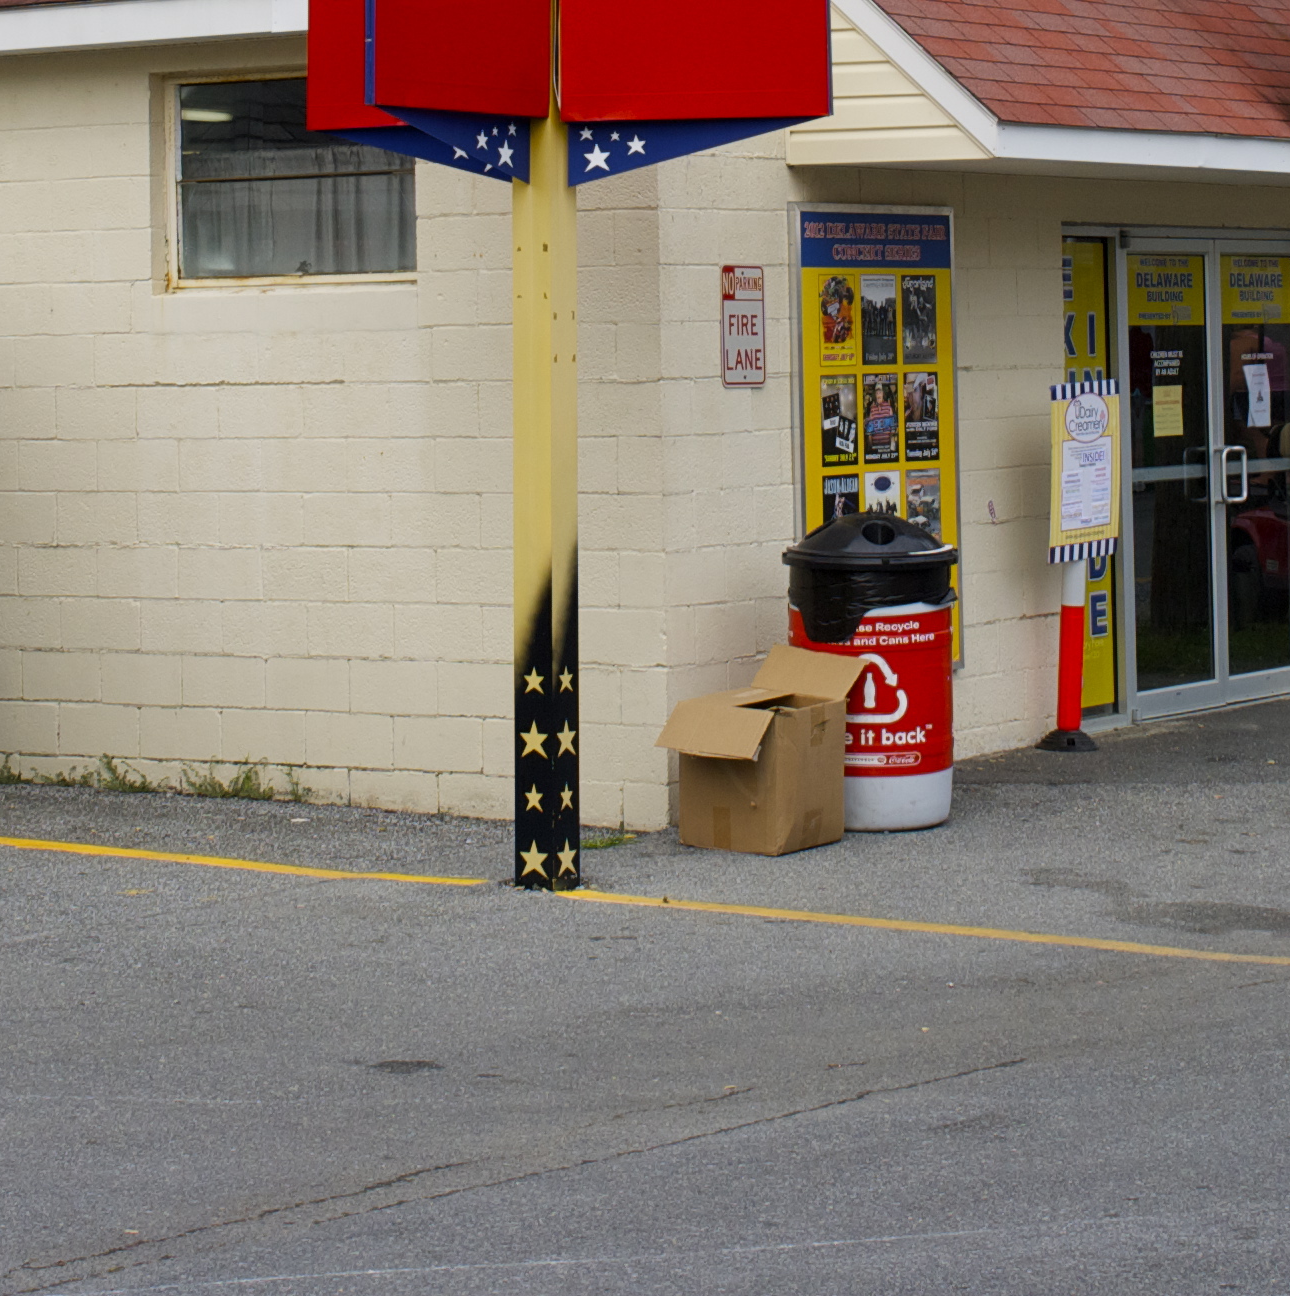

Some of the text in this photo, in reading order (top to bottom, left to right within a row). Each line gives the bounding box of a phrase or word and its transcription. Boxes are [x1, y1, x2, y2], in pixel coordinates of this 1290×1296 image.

[826, 222, 886, 240] DELAWARE
[888, 223, 920, 240] STATE
[922, 224, 946, 241] FAIR
[832, 244, 883, 261] CONCERT
[722, 272, 762, 295] NO PARKING
[1136, 272, 1193, 288] DELAWARE
[1229, 272, 1283, 288] DELAWARE
[1147, 290, 1183, 302] BUILDING
[1240, 290, 1274, 302] BUILDING
[729, 314, 758, 336] FIRE
[726, 349, 762, 371] LANE
[1069, 418, 1105, 434] Creamery
[876, 621, 920, 633] Recycle
[853, 636, 876, 646] and
[879, 635, 909, 645] Cans
[911, 632, 935, 643] Here
[861, 728, 875, 745] it
[881, 726, 926, 745] back
